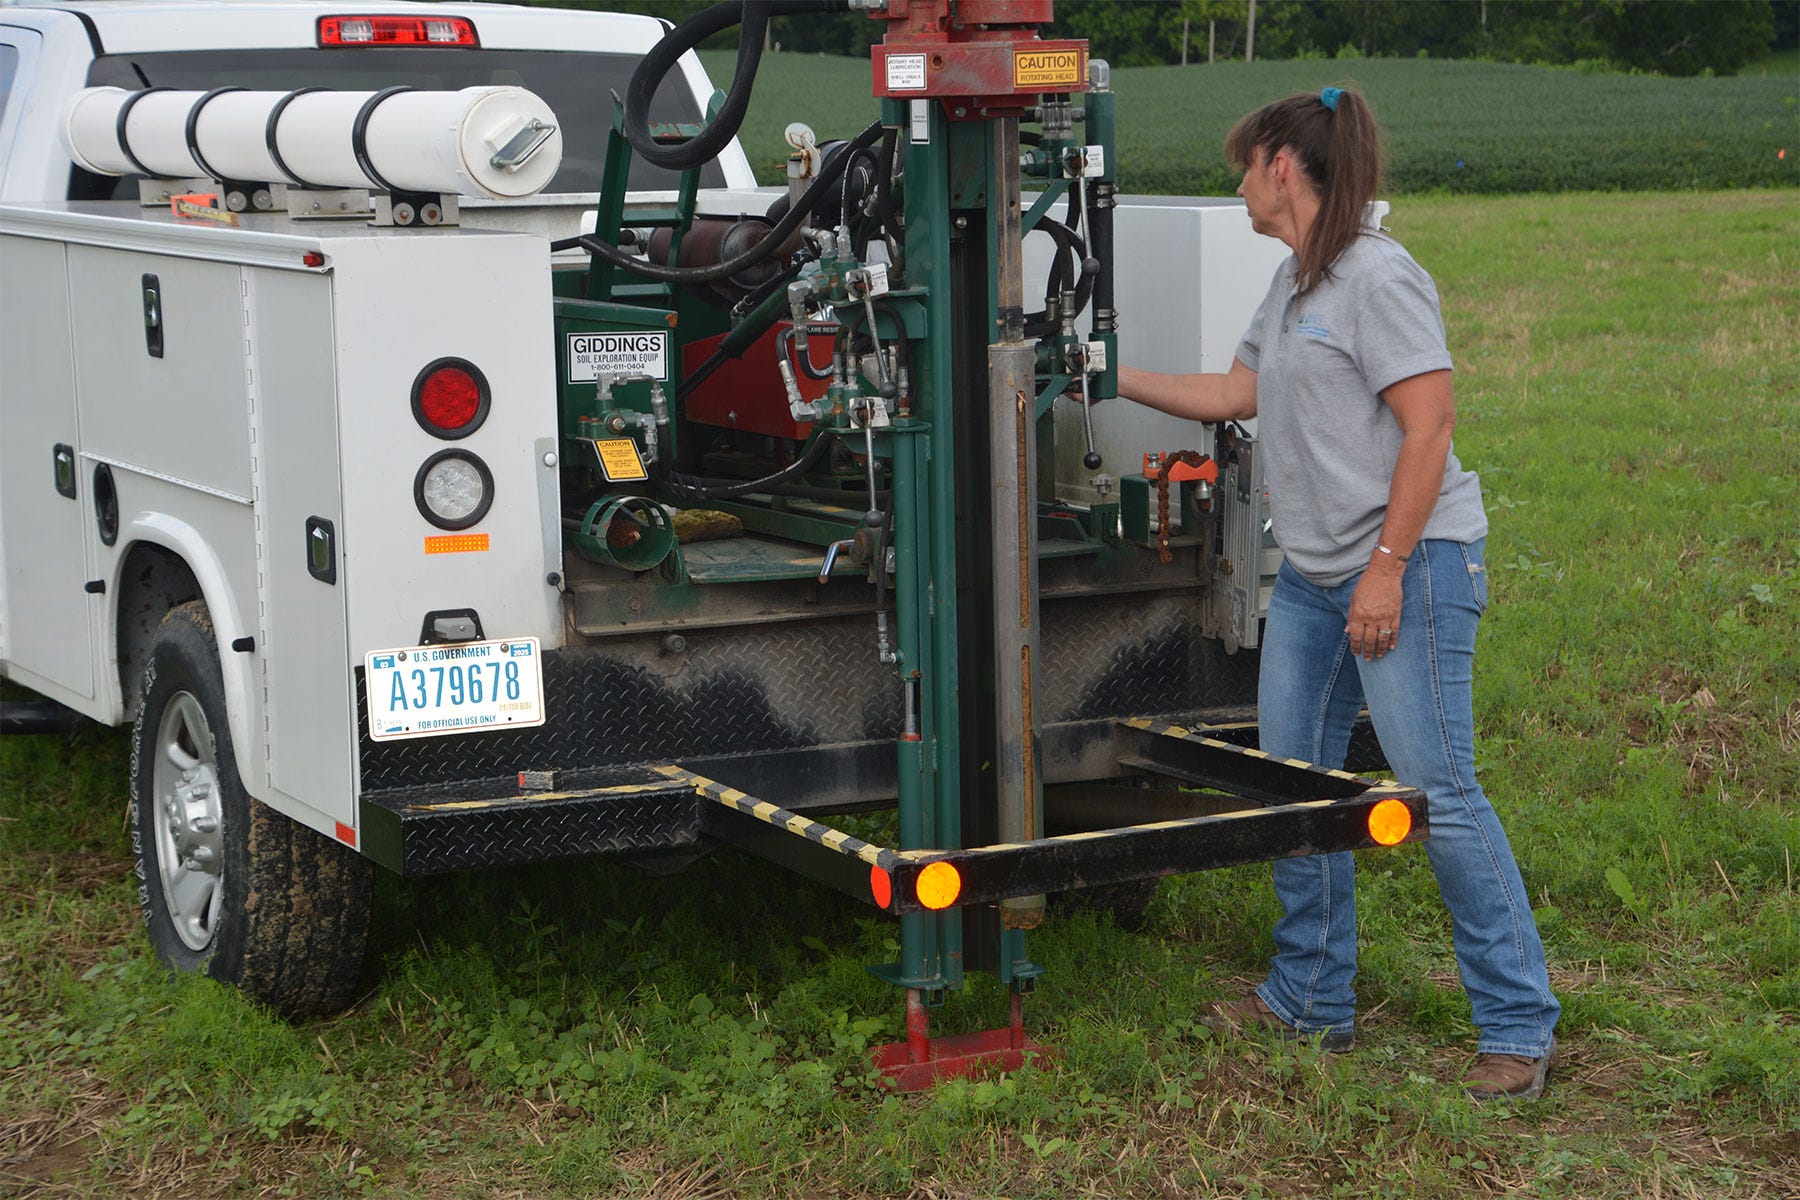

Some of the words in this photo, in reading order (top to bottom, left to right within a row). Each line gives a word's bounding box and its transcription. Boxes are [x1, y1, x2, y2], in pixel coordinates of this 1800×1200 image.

[1018, 56, 1076, 69] CAUTION
[574, 336, 661, 354] GIDDINGS
[576, 355, 592, 364] SOIL
[594, 354, 636, 362] EXPLORATION
[640, 353, 658, 362] EQUIP
[414, 652, 431, 662] U.S.
[432, 646, 492, 661] GOVERNMENT
[390, 660, 520, 712] A379678
[418, 720, 432, 730] FOR
[433, 718, 464, 728] OFFICIAL
[464, 716, 478, 726] USE
[480, 714, 496, 724] ONLY
